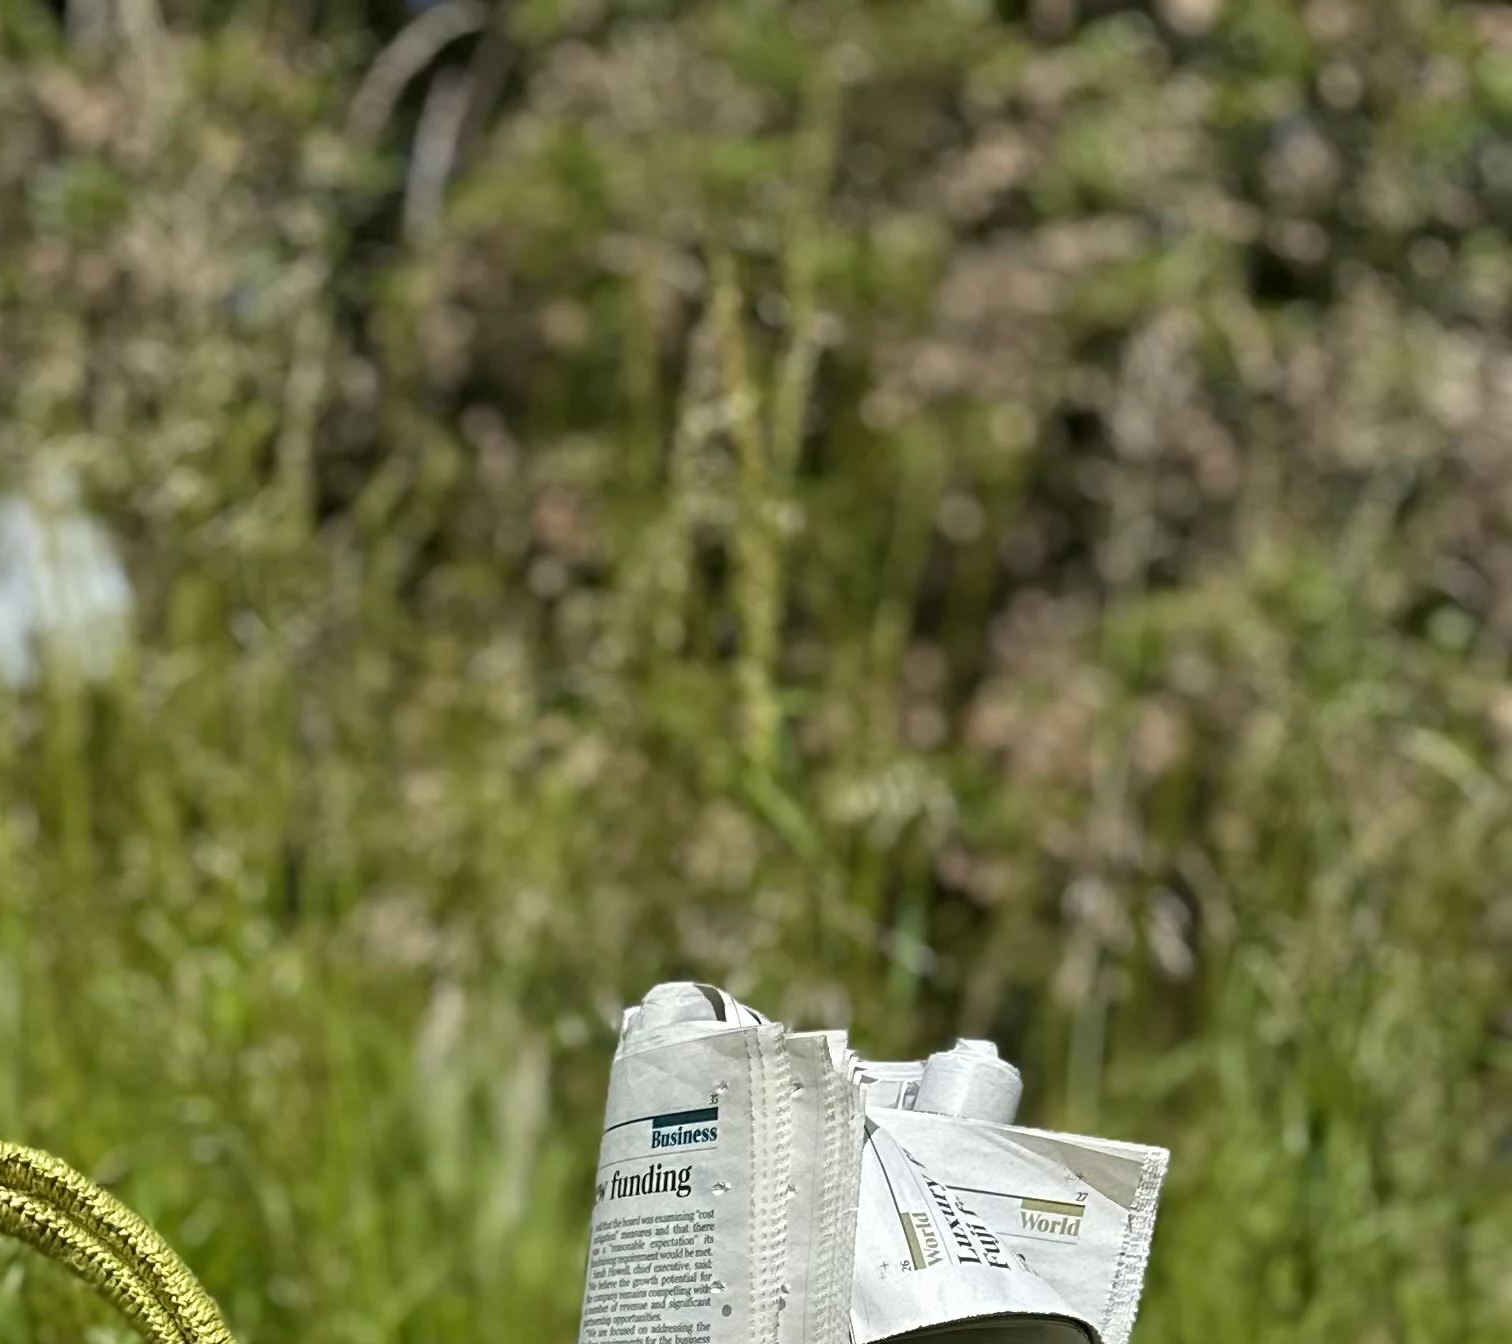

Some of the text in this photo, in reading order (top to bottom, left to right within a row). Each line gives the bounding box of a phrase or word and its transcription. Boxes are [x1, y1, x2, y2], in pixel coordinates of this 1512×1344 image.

[652, 1127, 717, 1149] Business
[610, 1163, 692, 1200] funding
[1075, 1192, 1088, 1201] 27
[922, 1174, 982, 1265] Luxury
[1021, 1211, 1081, 1237] World
[655, 1226, 669, 1235] and
[673, 1224, 689, 1233] that
[693, 1223, 714, 1231] there
[704, 1236, 714, 1244] its
[911, 1212, 943, 1266] World
[966, 1223, 1011, 1270] Fuji
[660, 1248, 683, 1260] would
[685, 1248, 694, 1257] be
[902, 1260, 911, 1272] 26
[619, 1278, 630, 1287] the
[661, 1272, 696, 1285] potential
[700, 1272, 712, 1281] for
[648, 1286, 692, 1300] compelling
[693, 1285, 711, 1293] with
[651, 1298, 665, 1308] and
[669, 1297, 711, 1311] significant
[638, 1326, 647, 1334] on
[651, 1322, 693, 1335] addressing
[697, 1322, 711, 1331] the
[645, 1336, 656, 1344] for
[659, 1336, 672, 1344] the
[675, 1335, 710, 1344] business
